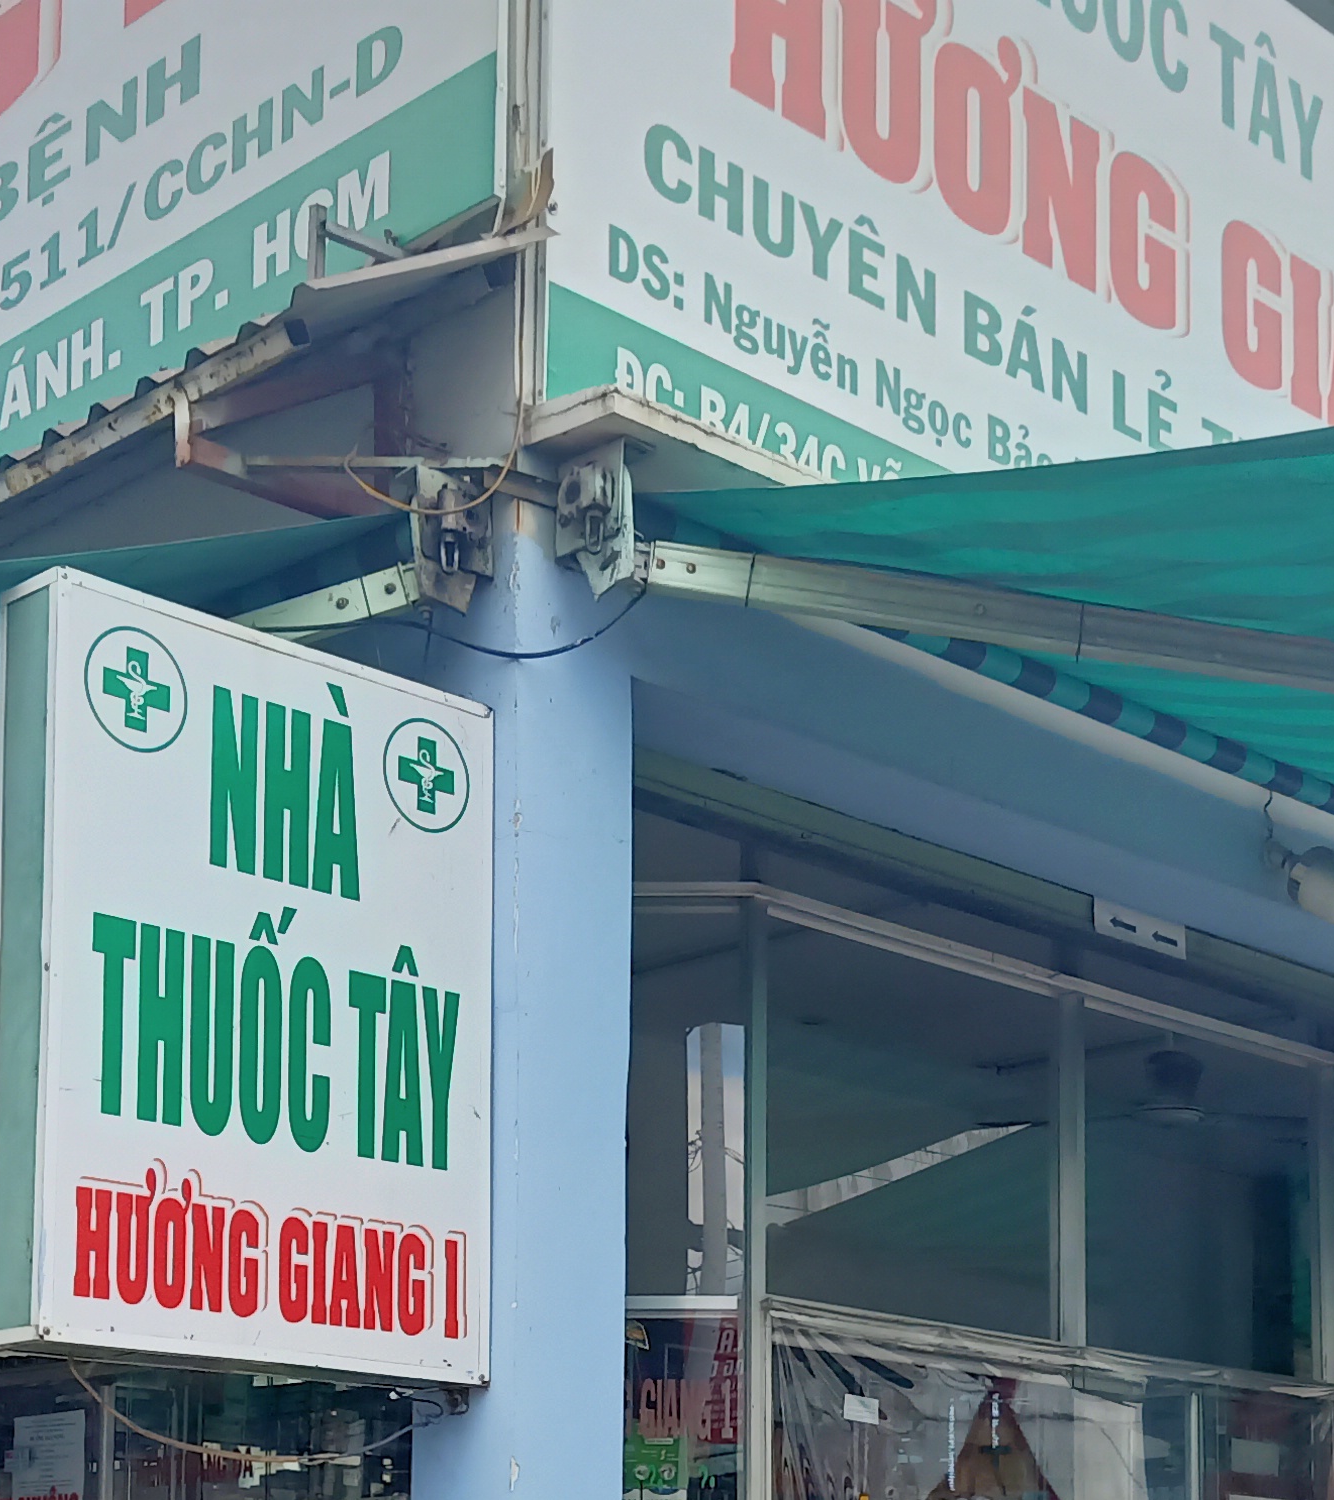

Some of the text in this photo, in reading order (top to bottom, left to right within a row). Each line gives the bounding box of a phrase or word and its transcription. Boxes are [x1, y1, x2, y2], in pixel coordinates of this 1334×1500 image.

[729, 0, 1190, 338] HƯƠNG
[1208, 21, 1323, 182] TÂY
[140, 259, 230, 348] TP.
[252, 150, 392, 285] HCM
[608, 223, 685, 311] DS:
[703, 271, 859, 397] Nguyễn
[875, 358, 973, 449] Ngọc
[643, 123, 1179, 452] CHUYÊN BÁN LẺ
[209, 682, 361, 902] NHÀ
[92, 906, 461, 1171] THUỐC TÂY
[73, 1164, 264, 1318] HƯƠNG
[278, 1212, 431, 1337] GIANG
